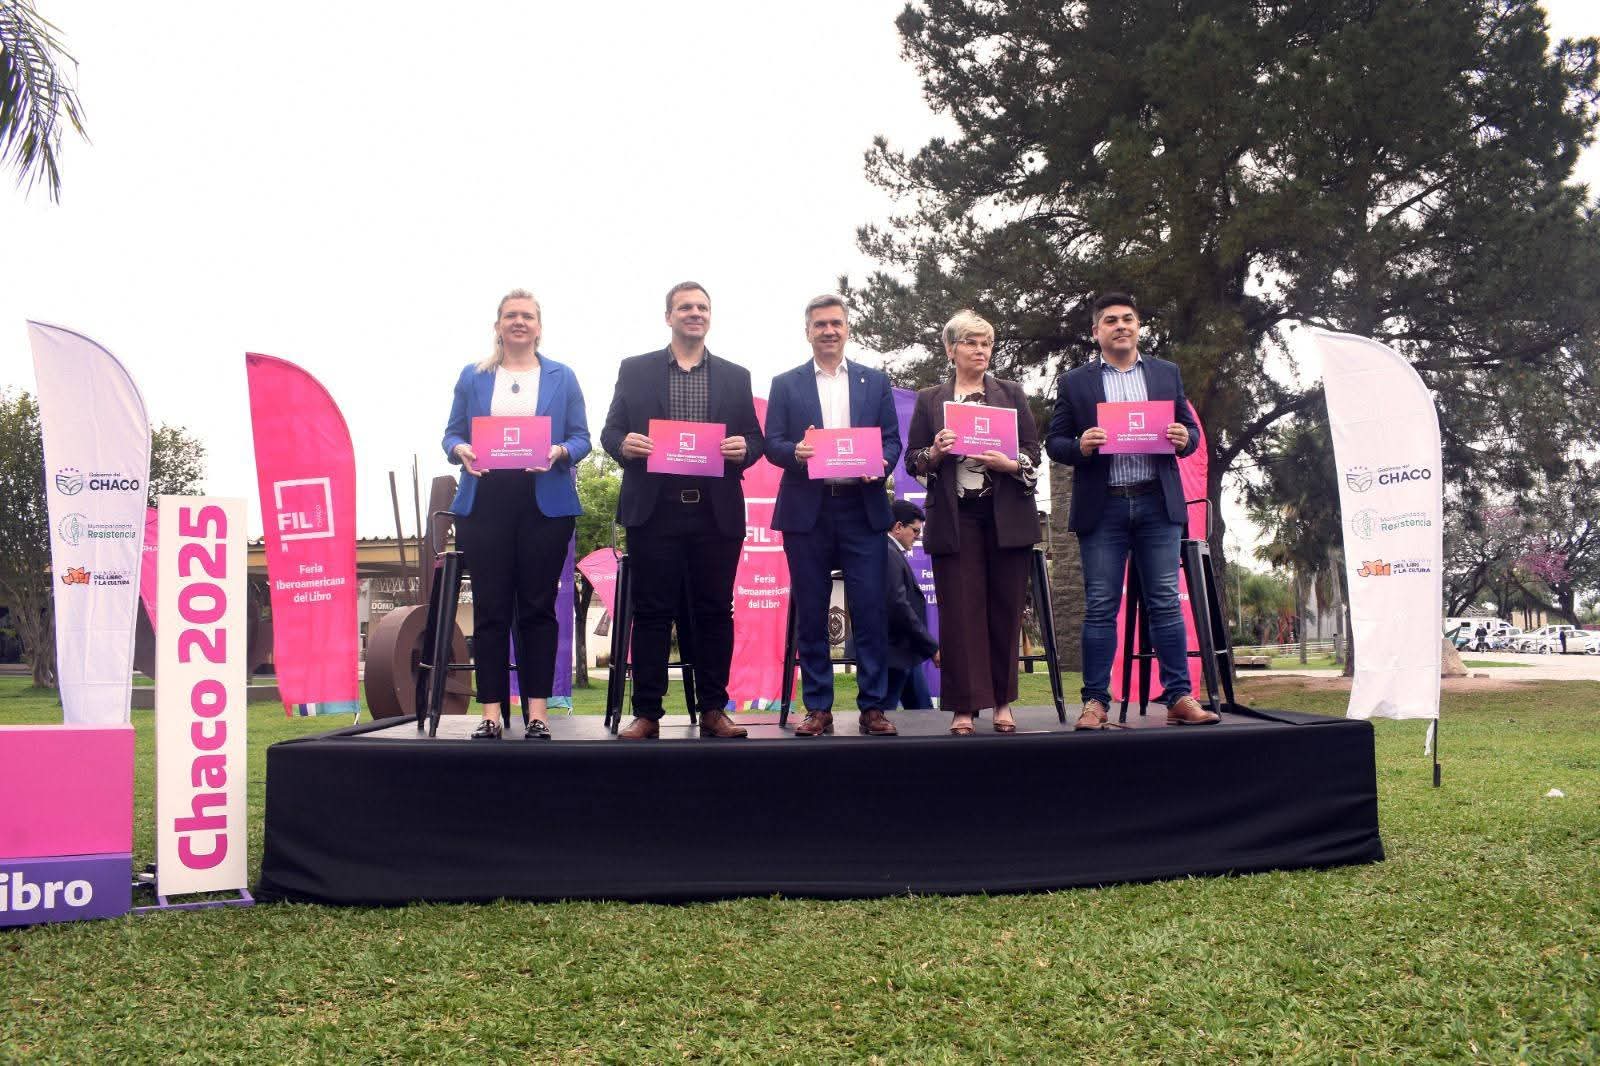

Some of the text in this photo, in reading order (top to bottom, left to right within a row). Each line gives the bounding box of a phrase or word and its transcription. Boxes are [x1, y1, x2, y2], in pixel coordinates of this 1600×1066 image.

[1379, 469, 1431, 485] CHACO
[89, 479, 139, 491] CHACO
[278, 512, 313, 530] FIL
[1382, 519, 1431, 531] Resistencia
[88, 530, 136, 539] Resistencia
[300, 564, 322, 573] Feria
[277, 577, 344, 590] Iberoamericana
[294, 591, 331, 602] del Libro
[371, 602, 394, 610] DOMO
[748, 600, 759, 608] del
[175, 505, 228, 870] Chaco 2025
[0, 871, 93, 912] ibro
